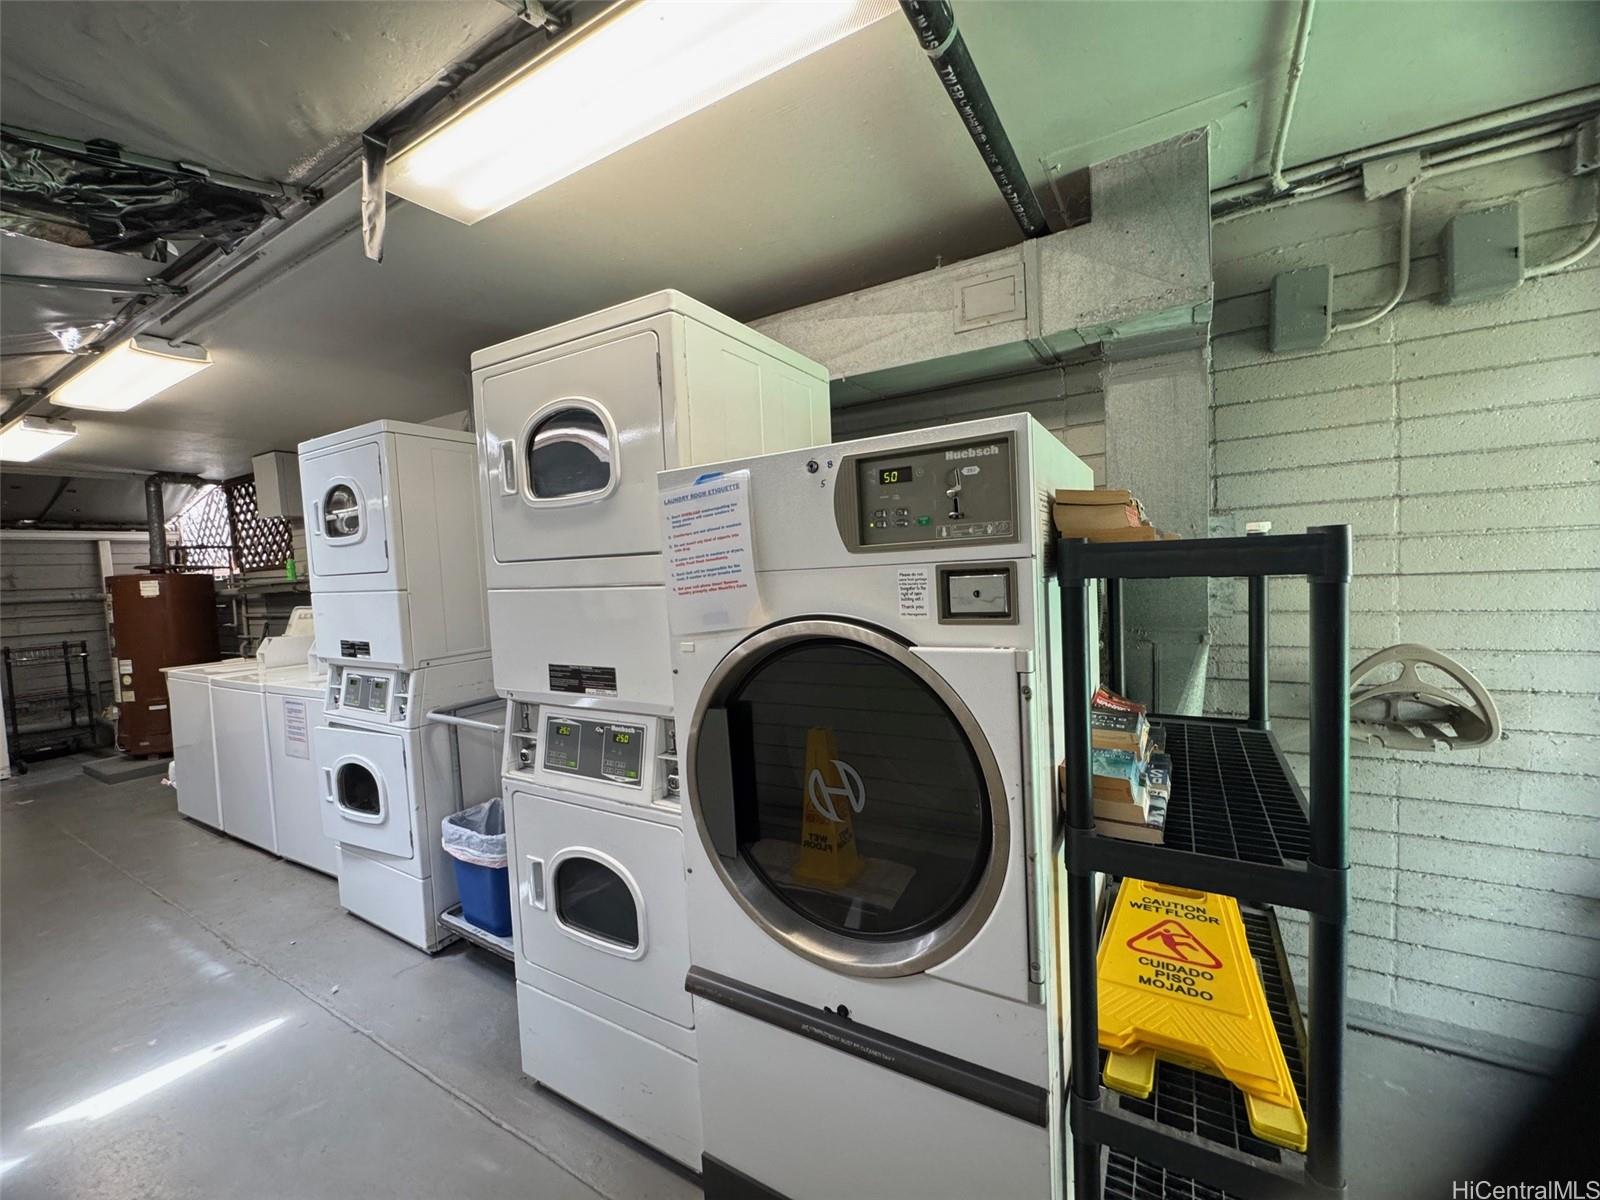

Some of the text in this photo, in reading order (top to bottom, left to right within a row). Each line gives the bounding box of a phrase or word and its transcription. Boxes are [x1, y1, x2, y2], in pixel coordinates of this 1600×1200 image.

[941, 65, 964, 101] TYLER
[946, 445, 999, 460] Huebsch
[884, 471, 898, 483] 50
[664, 483, 740, 506] LAUNDRY ROOM ETIQUETTE
[1129, 901, 1220, 925] WET FLOOR
[1142, 896, 1206, 915] CAUTION
[1138, 956, 1214, 981] CUIDADO
[1155, 970, 1195, 986] PISO
[1138, 975, 1214, 1001] MOJADO
